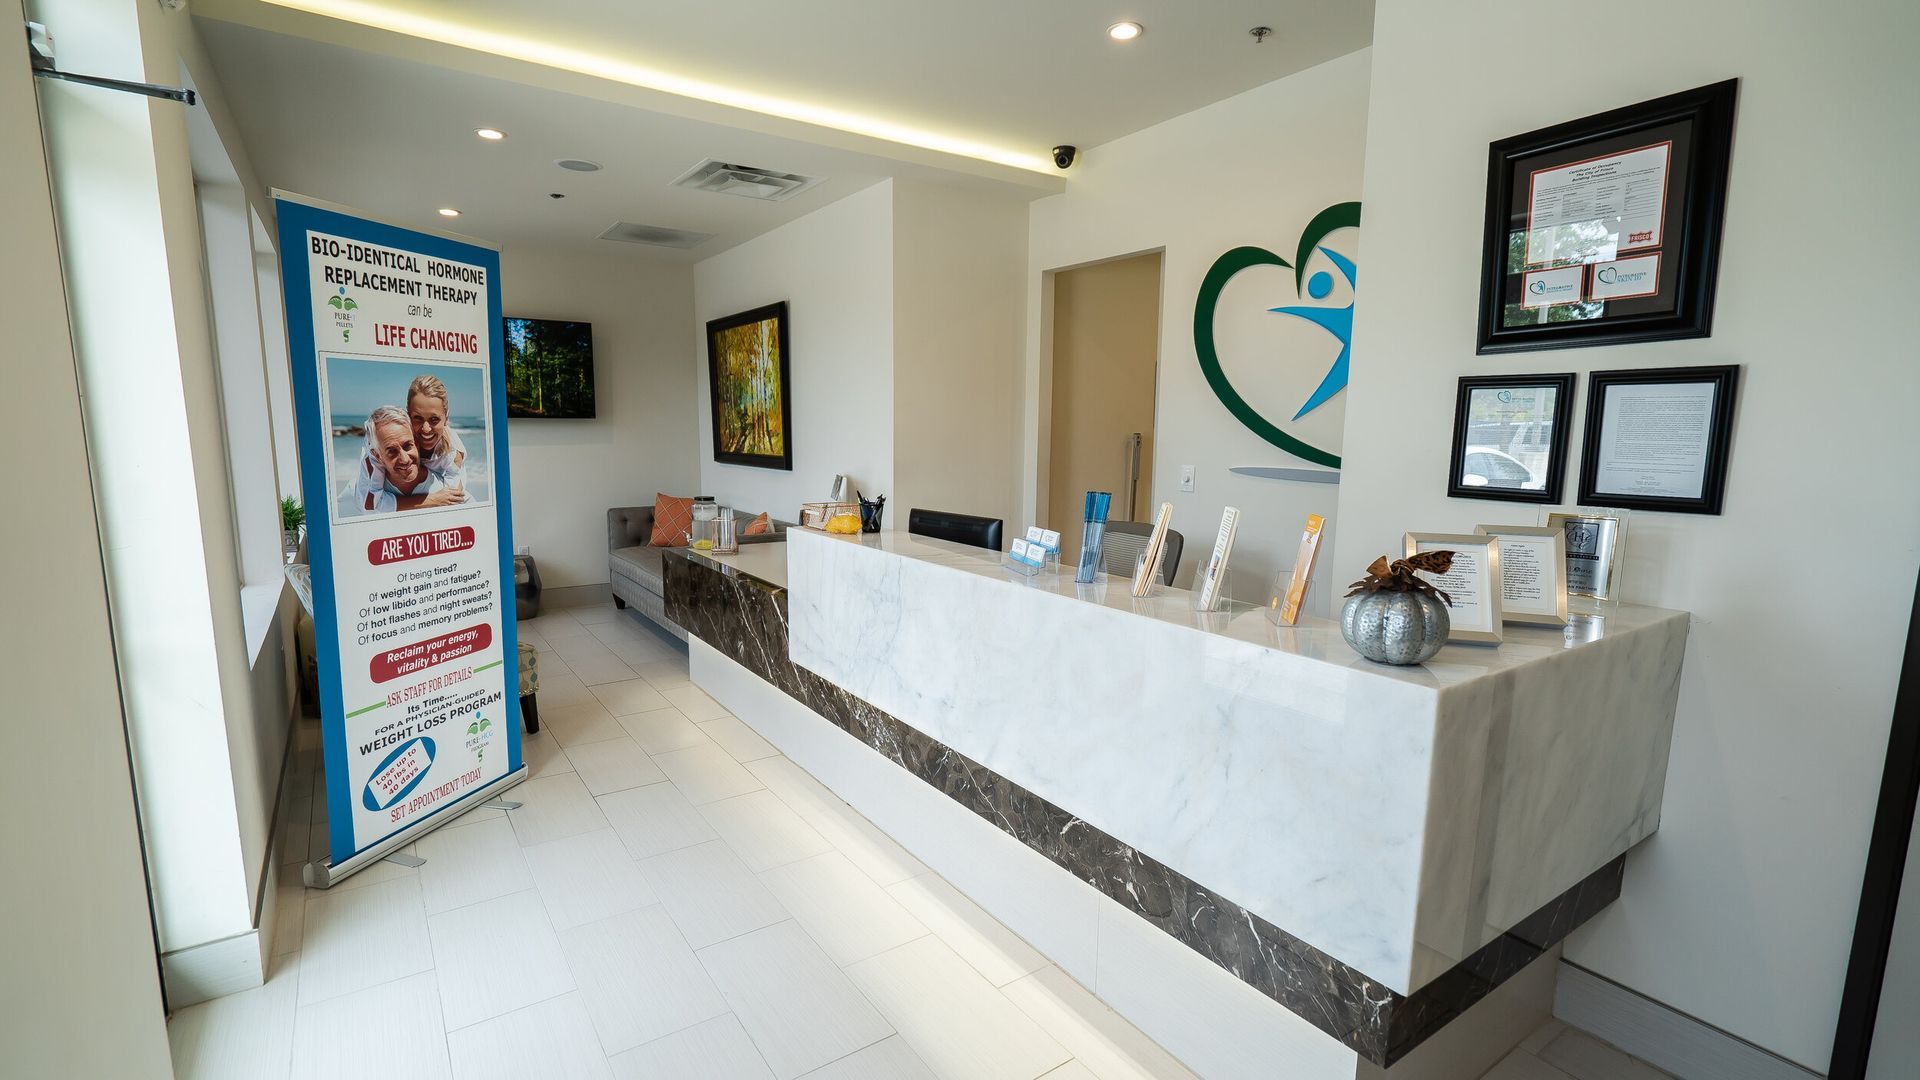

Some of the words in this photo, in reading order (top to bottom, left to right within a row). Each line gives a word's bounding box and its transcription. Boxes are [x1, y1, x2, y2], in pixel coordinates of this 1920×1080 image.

[1631, 233, 1650, 241] FRISCO
[312, 236, 420, 274] BIO-IDENTICAL
[427, 260, 484, 286] HORMONE
[324, 266, 422, 299] REPLACEMENT
[426, 284, 478, 306] THERAPY
[408, 304, 420, 316] can
[422, 304, 432, 318] be
[374, 323, 406, 348] LIFE
[410, 327, 478, 354] CHANGING
[381, 538, 404, 560] ARE
[406, 533, 430, 556] YOU
[432, 530, 473, 552] TIRED....
[380, 586, 412, 600] weight
[414, 582, 432, 594] gain
[434, 578, 448, 588] and
[450, 570, 481, 585] fatigue?
[397, 573, 408, 582] Of
[410, 569, 432, 582] being
[434, 563, 458, 576] tired?
[357, 622, 370, 632] Of
[371, 618, 386, 630] hot
[389, 610, 420, 625] flashes
[423, 604, 438, 616] and
[440, 599, 460, 613] night
[462, 591, 492, 606] sweats?
[359, 607, 370, 618] Of
[373, 603, 390, 616] low
[392, 598, 416, 610] libido
[418, 592, 434, 604] and
[436, 580, 490, 602] performance?
[358, 635, 370, 646] Of
[372, 628, 398, 642] focus
[400, 623, 416, 634] and
[418, 615, 452, 630] memory
[454, 602, 492, 622] problems?
[386, 645, 424, 664] Reclaim
[426, 638, 446, 654] your
[448, 629, 478, 645] energy,
[396, 658, 430, 674] vitality
[432, 654, 438, 663] &
[440, 644, 472, 663] passion
[386, 692, 402, 708] ASK
[404, 684, 426, 704] STAFF
[429, 676, 442, 693] FOR
[444, 666, 472, 688] DETAILS
[374, 724, 396, 736] FOR
[397, 720, 404, 728] A
[406, 688, 486, 724] PHYSICIAN-GUIDED
[407, 702, 420, 714] Its
[422, 693, 458, 708] Time.....
[360, 726, 414, 756] WEIGHT
[417, 714, 446, 733] LOSS
[450, 692, 502, 720] PROGRAM
[466, 730, 494, 748] PURE-HCG
[470, 742, 490, 752] PROGRAM
[376, 767, 395, 786] Lose
[396, 757, 407, 768] up
[408, 748, 416, 756] to
[382, 780, 392, 790] 40
[394, 768, 406, 780] lbs
[408, 759, 416, 768] in
[388, 784, 399, 794] 40
[400, 767, 418, 784] days
[390, 804, 406, 823] SET
[408, 778, 460, 814] APPOINTMENT
[460, 767, 482, 787] TODAY
